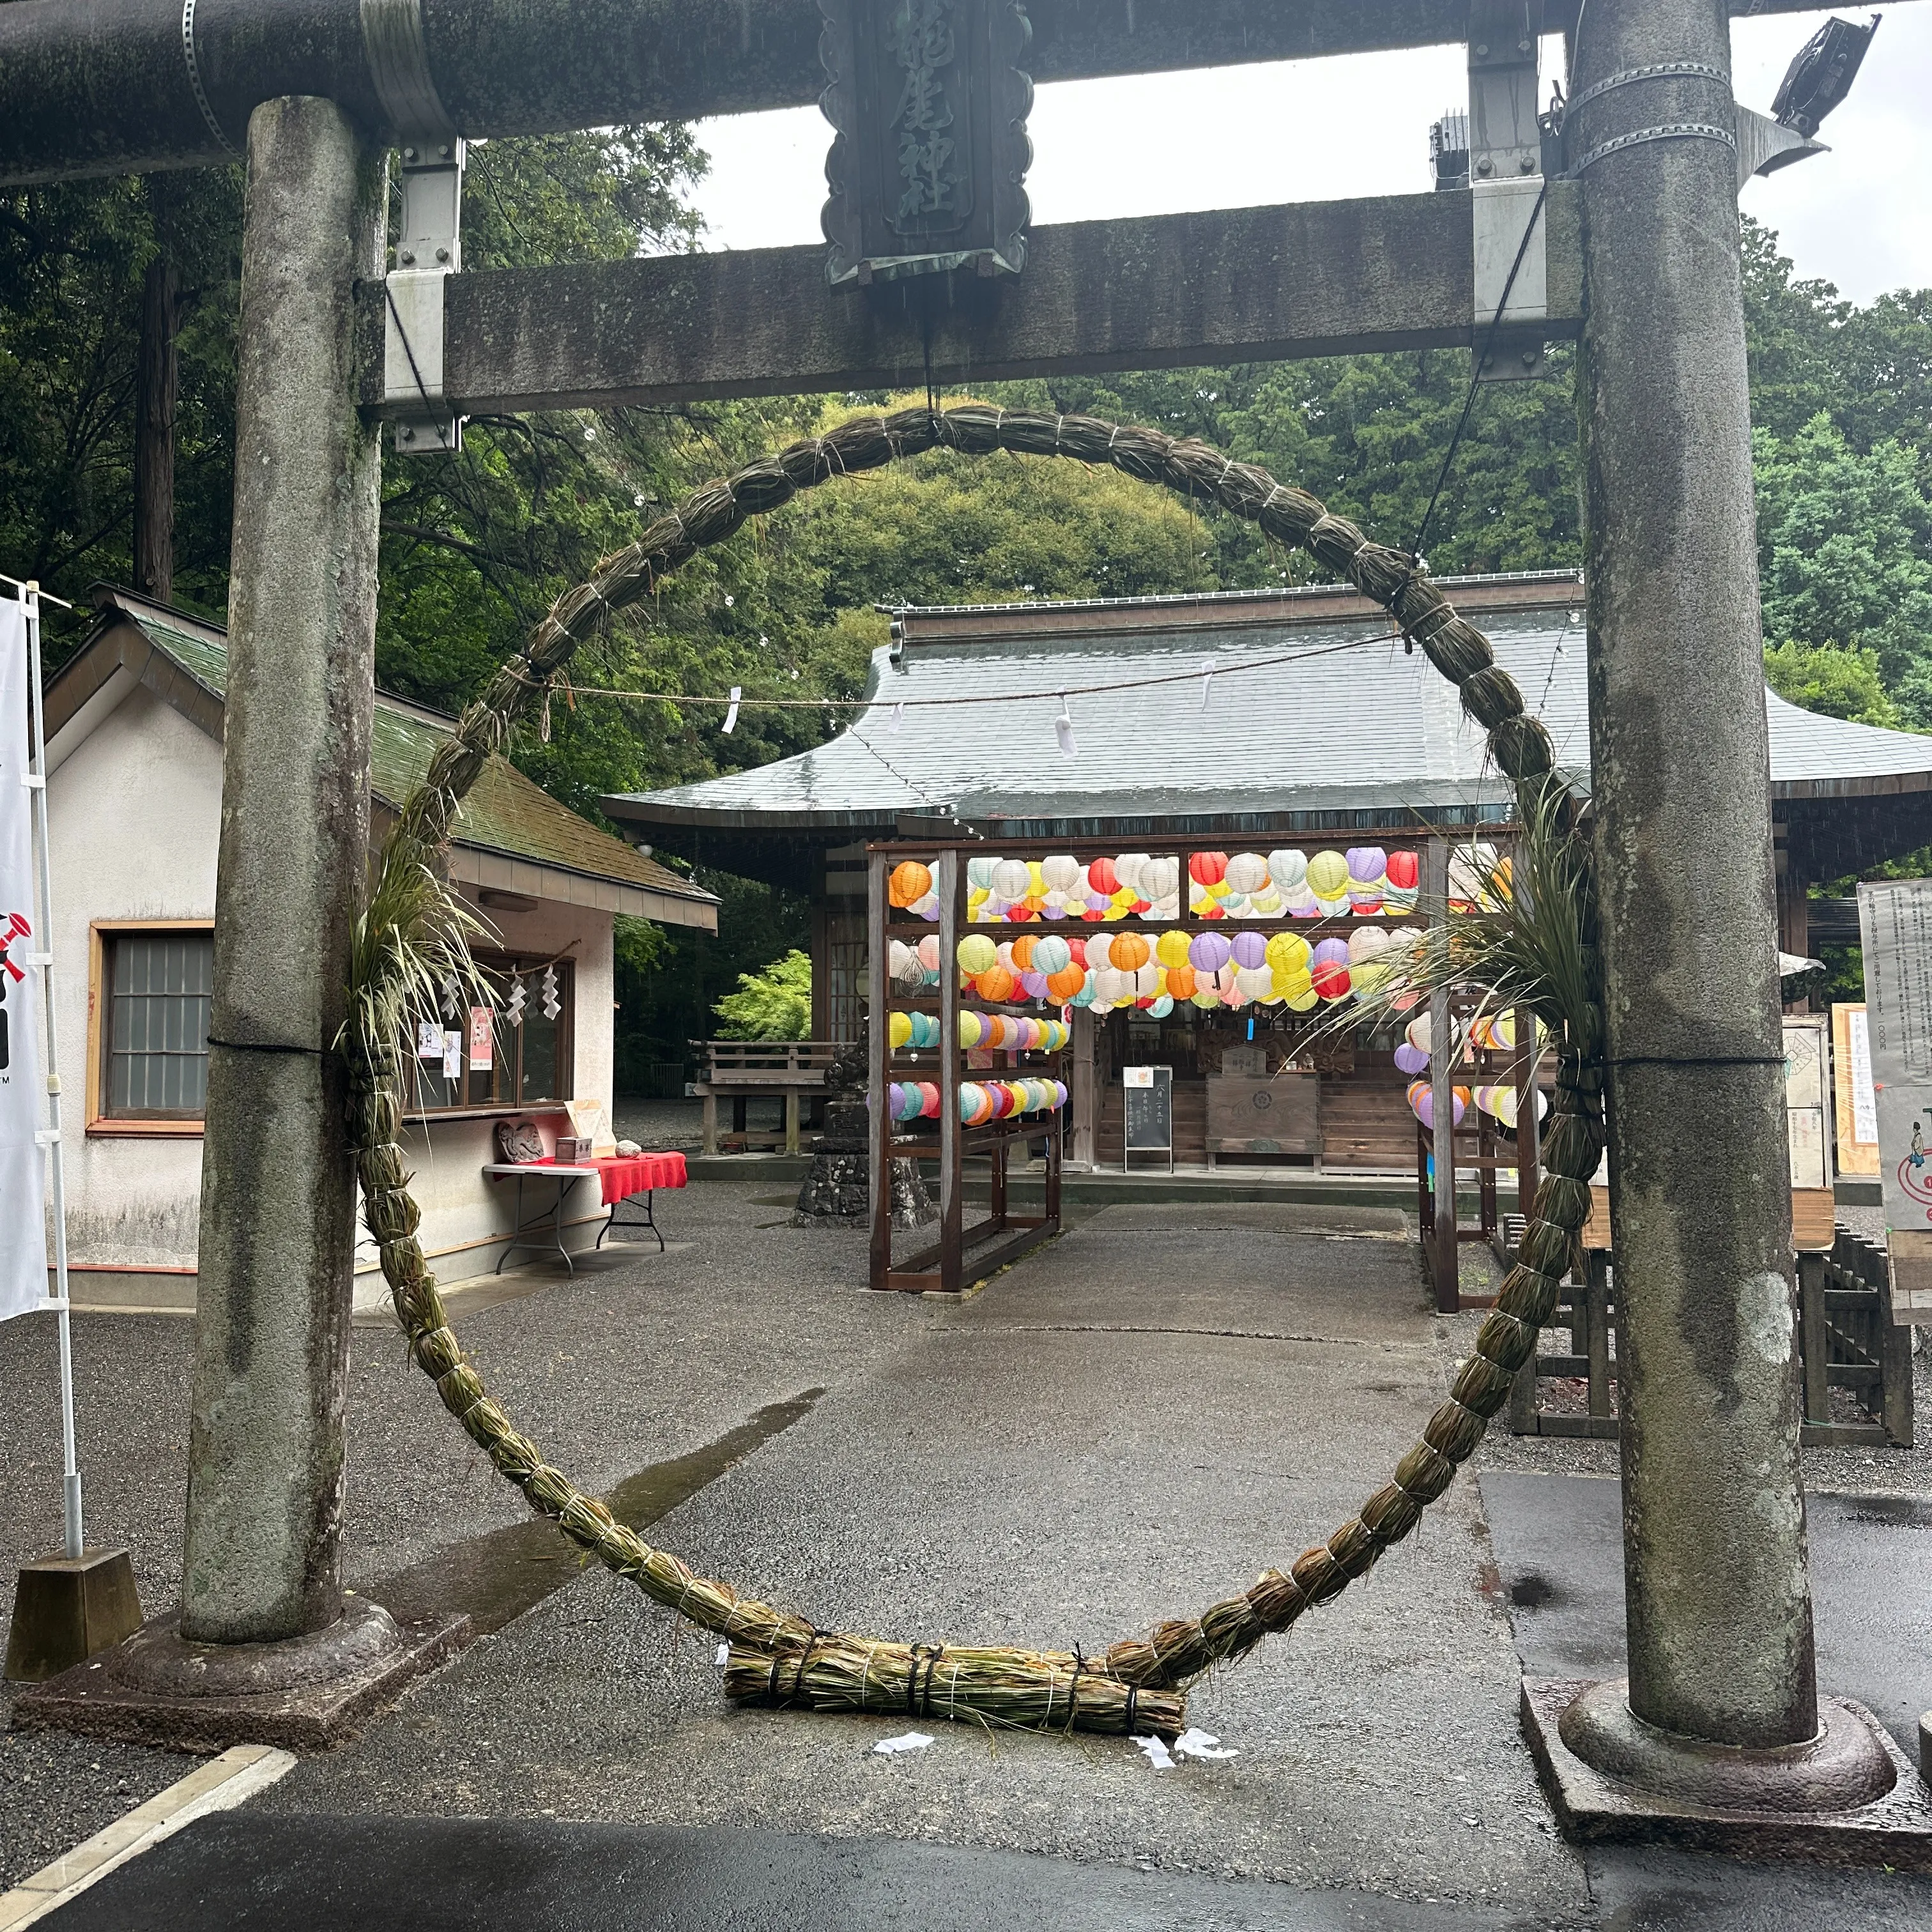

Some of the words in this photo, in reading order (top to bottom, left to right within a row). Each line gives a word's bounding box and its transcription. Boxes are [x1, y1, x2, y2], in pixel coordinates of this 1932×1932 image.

[1155, 1084, 1165, 1124] 六月二十五日
